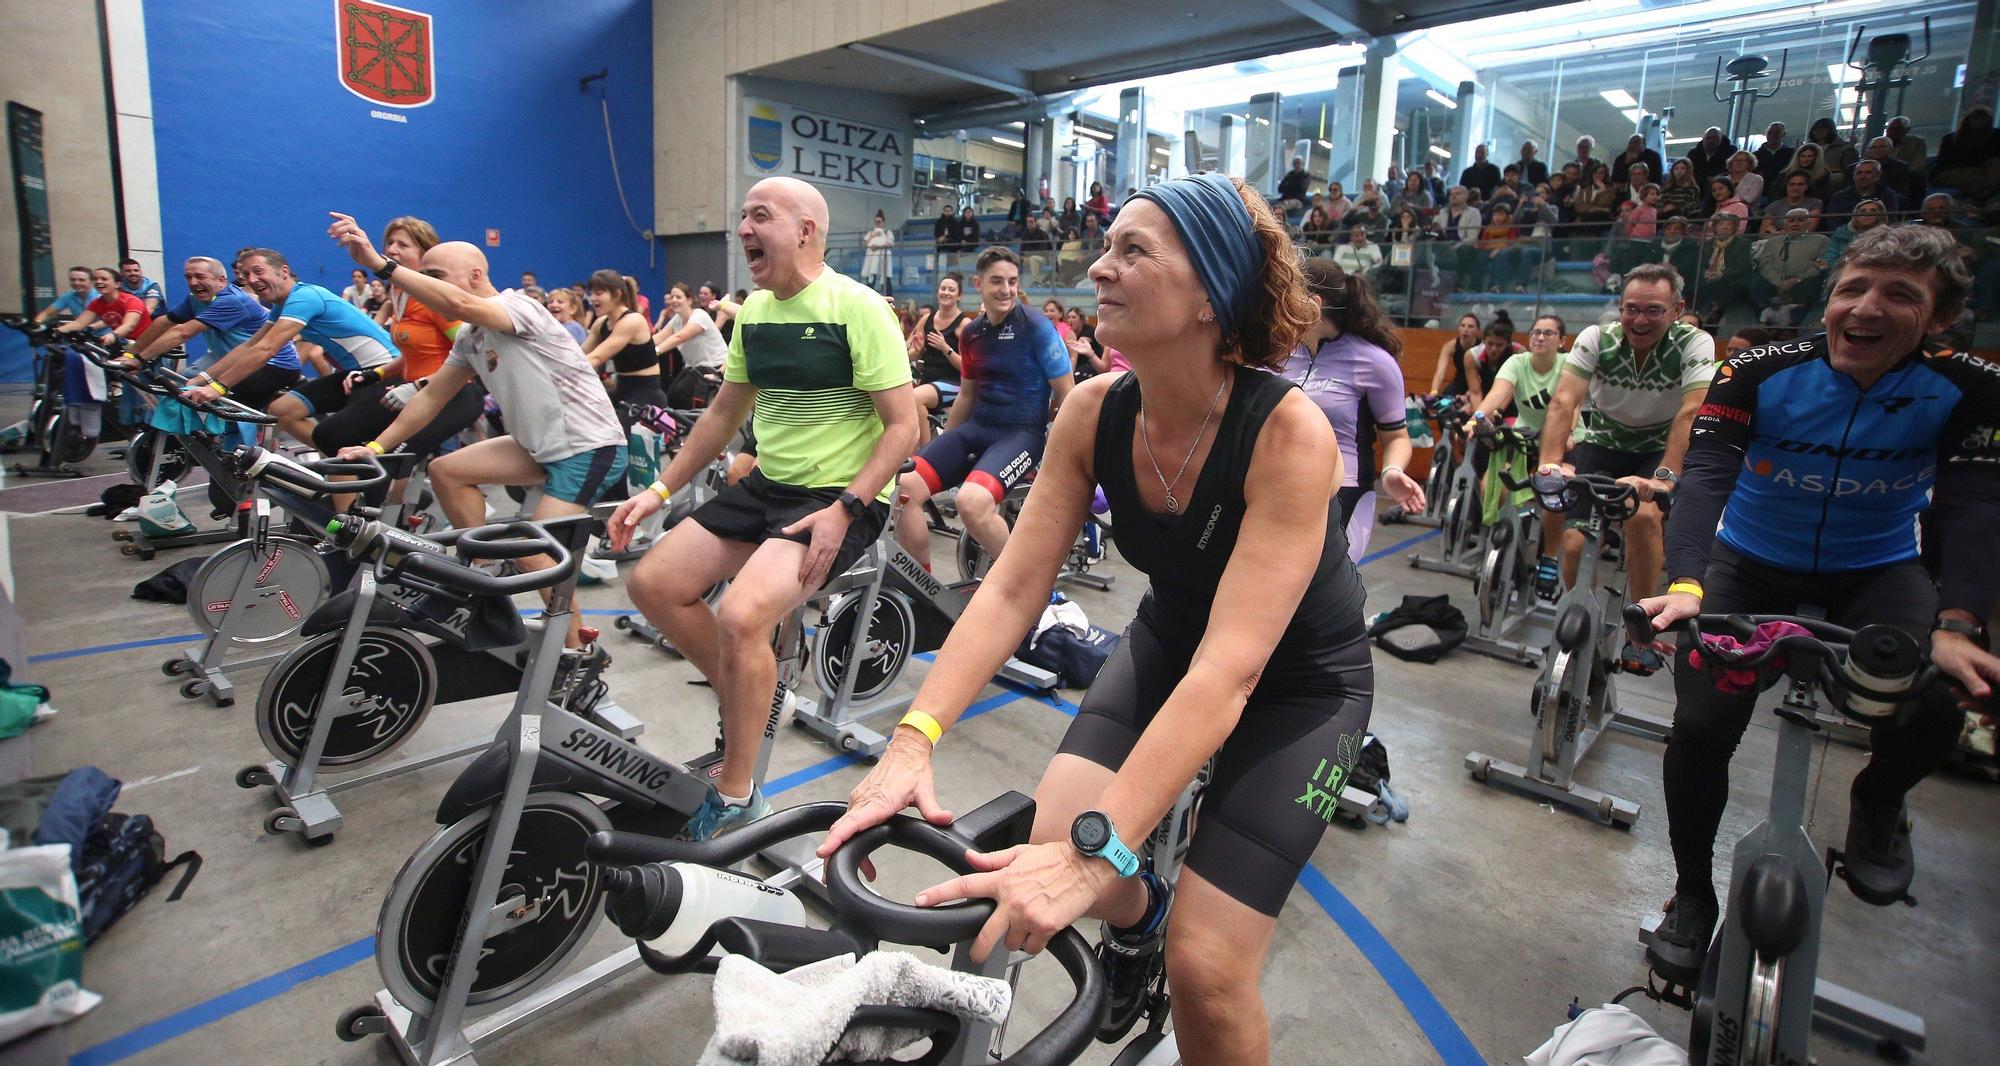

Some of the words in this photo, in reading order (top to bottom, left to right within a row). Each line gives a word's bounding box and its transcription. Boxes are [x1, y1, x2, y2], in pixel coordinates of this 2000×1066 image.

[791, 114, 903, 156] OLTZA
[792, 146, 902, 188] LEKU
[1728, 341, 1814, 369] ASPACE
[999, 464, 1013, 478] CLUB
[1010, 450, 1029, 469] CICLISTA
[1003, 457, 1032, 488] MILAGRO
[1773, 464, 1936, 498] ASPACE
[1197, 504, 1222, 550] ETXEONDO
[892, 551, 940, 597] SPINNING
[763, 681, 787, 739] SPINNER
[782, 663, 790, 681] PRO
[561, 728, 671, 790] SPINNING
